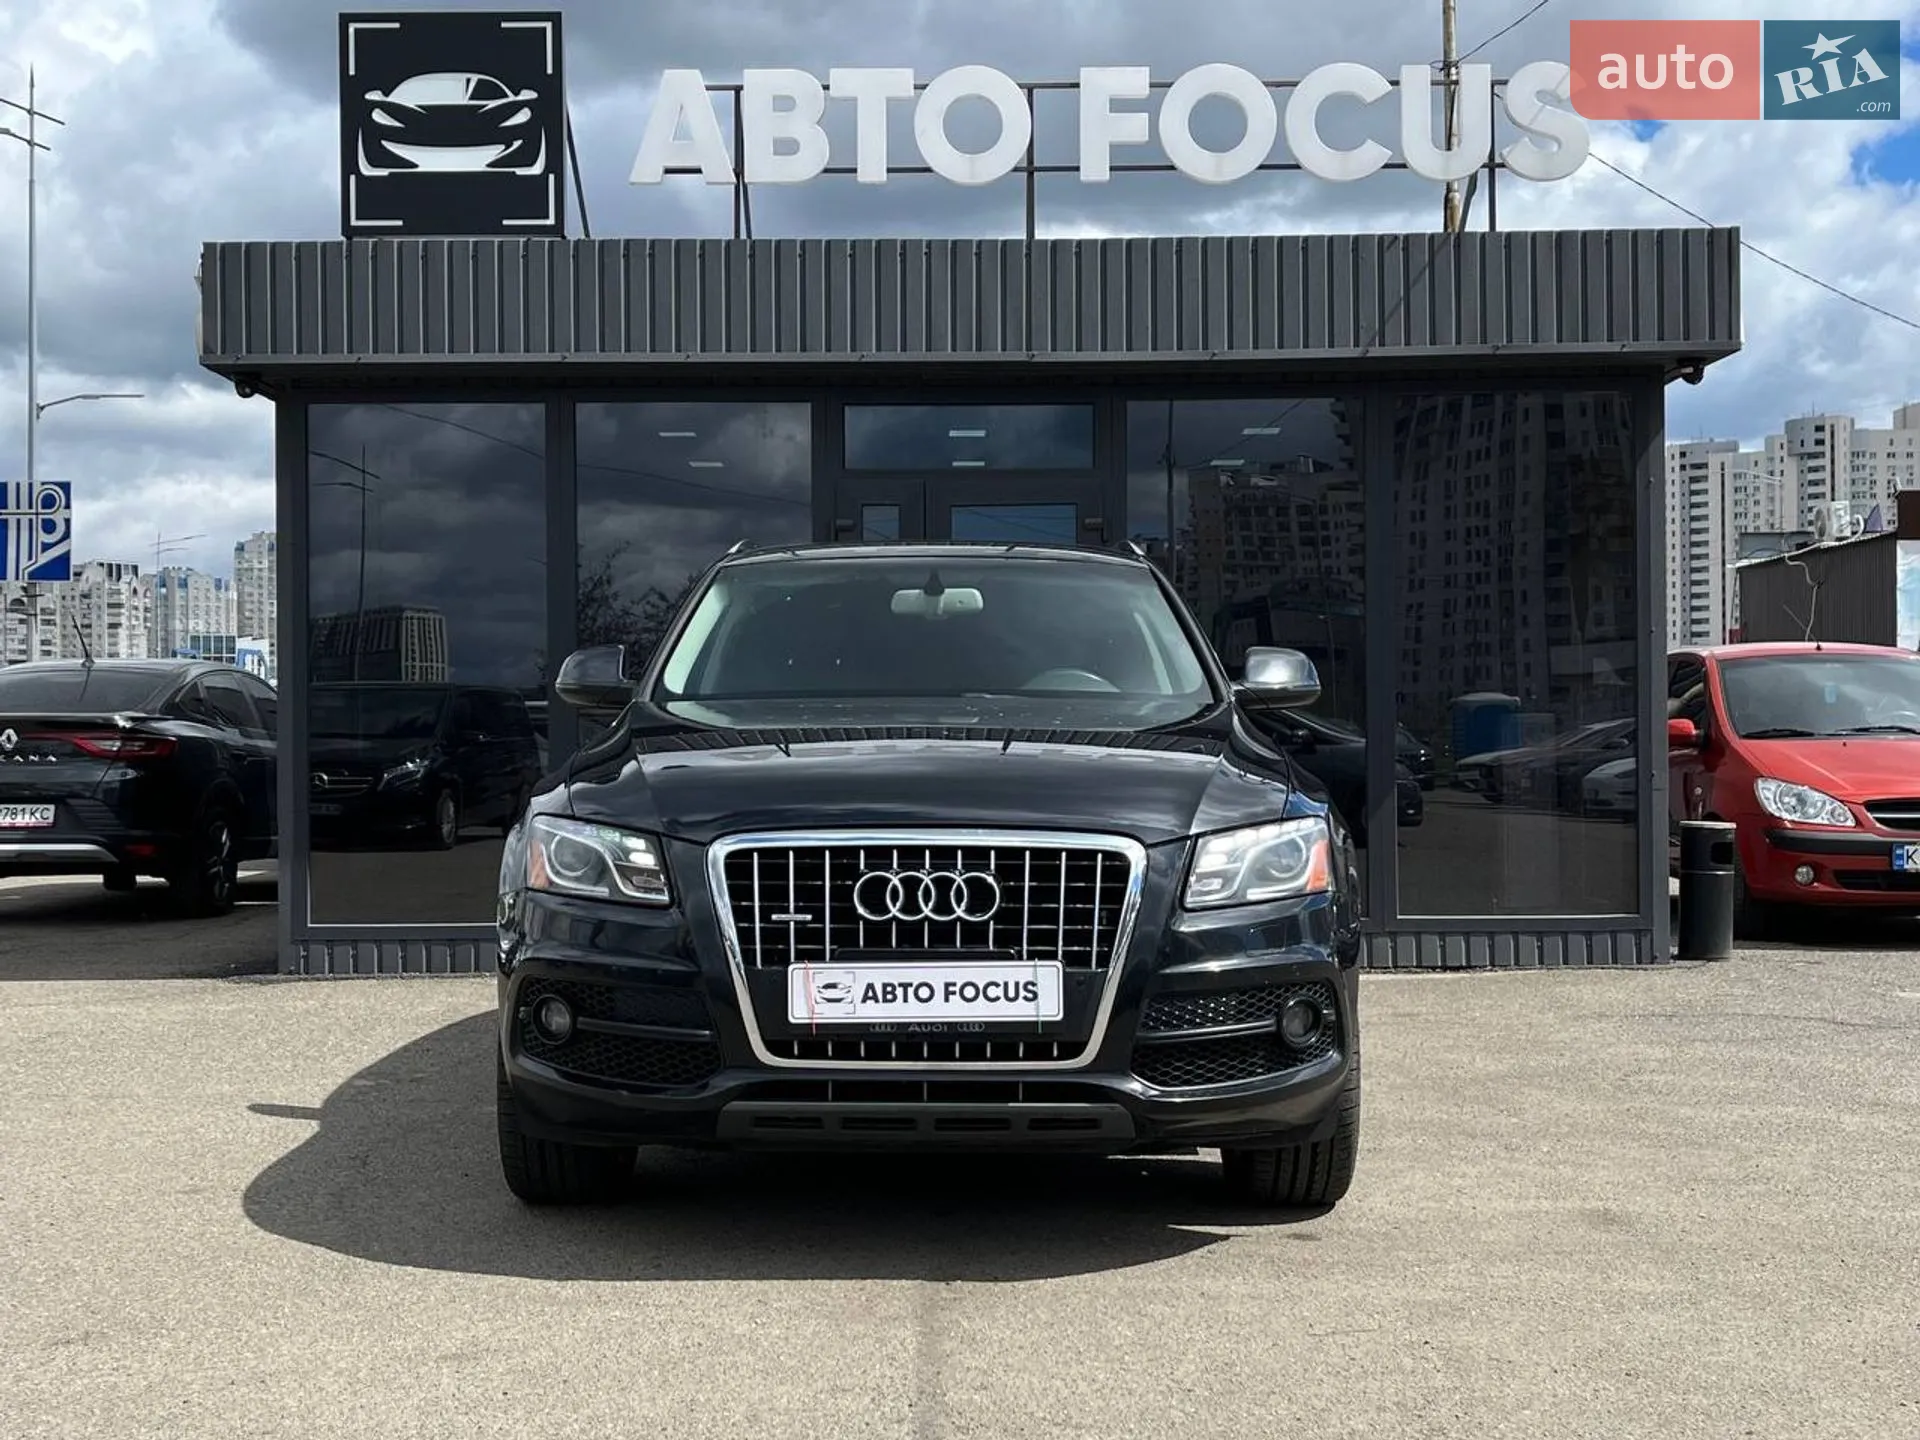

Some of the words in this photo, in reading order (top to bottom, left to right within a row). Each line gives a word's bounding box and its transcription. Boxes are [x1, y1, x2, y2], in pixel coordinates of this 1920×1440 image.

[629, 64, 1031, 186] АВТО
[1079, 61, 1590, 183] FOCUS
[861, 981, 935, 1004] АВТО
[943, 980, 1039, 1004] FOCUS
